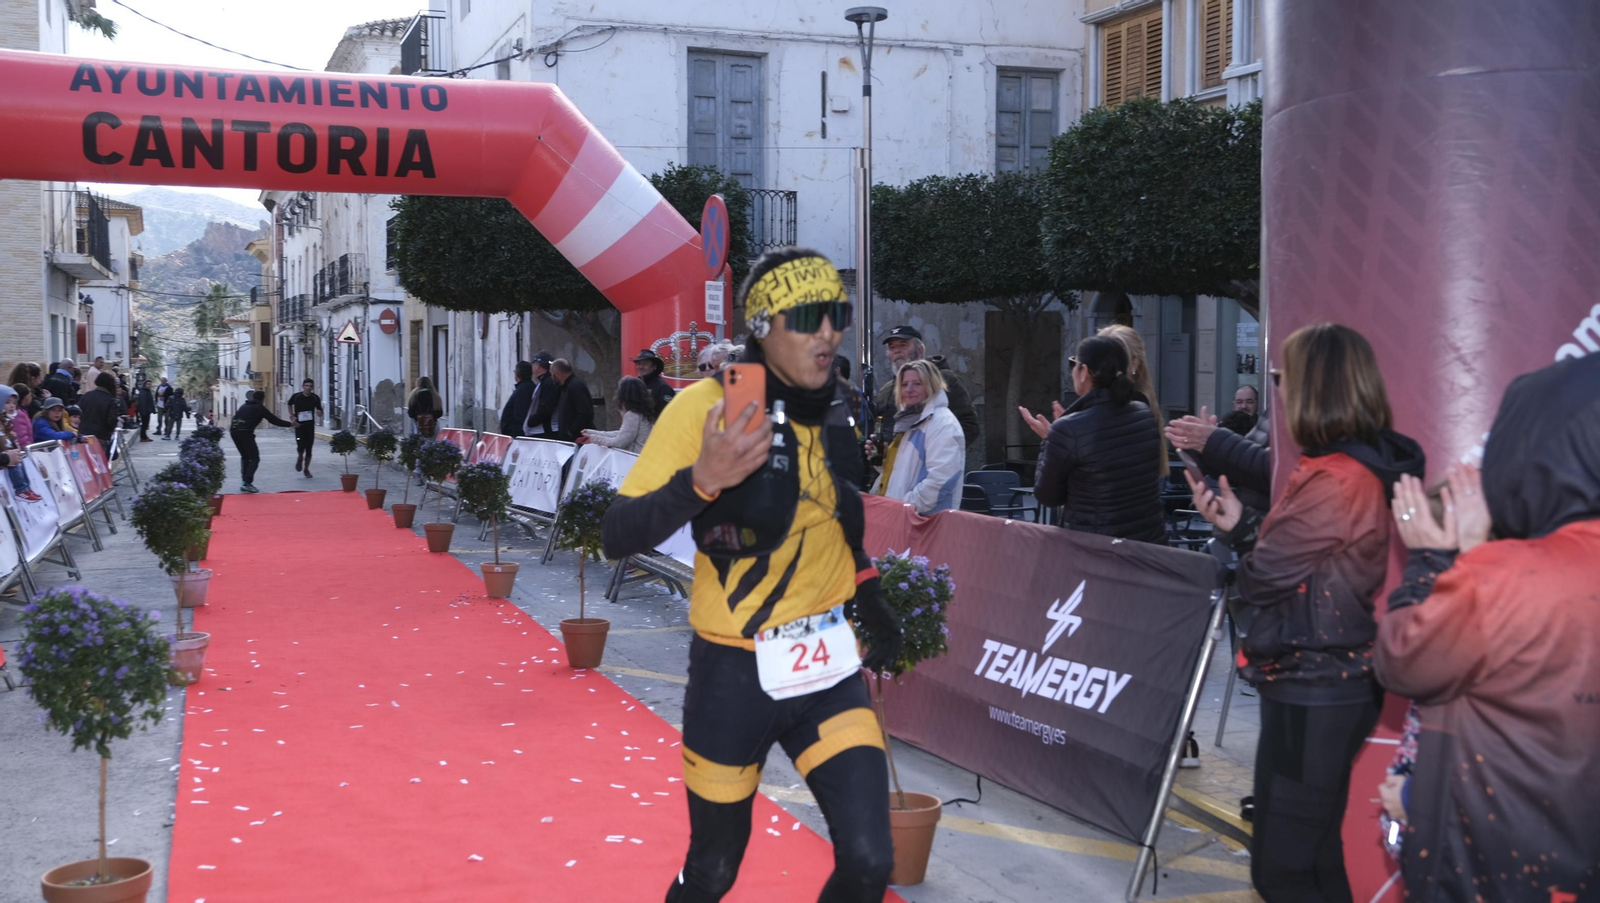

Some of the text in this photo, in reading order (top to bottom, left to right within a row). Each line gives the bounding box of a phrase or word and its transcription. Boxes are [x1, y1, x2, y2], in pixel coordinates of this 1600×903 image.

[69, 63, 448, 112] AYUNTAMIENTO
[82, 111, 437, 179] CANTORIA
[789, 638, 831, 673] 24
[974, 639, 1133, 714] TEAMERGY
[988, 705, 1067, 746] www.teamergy.es
